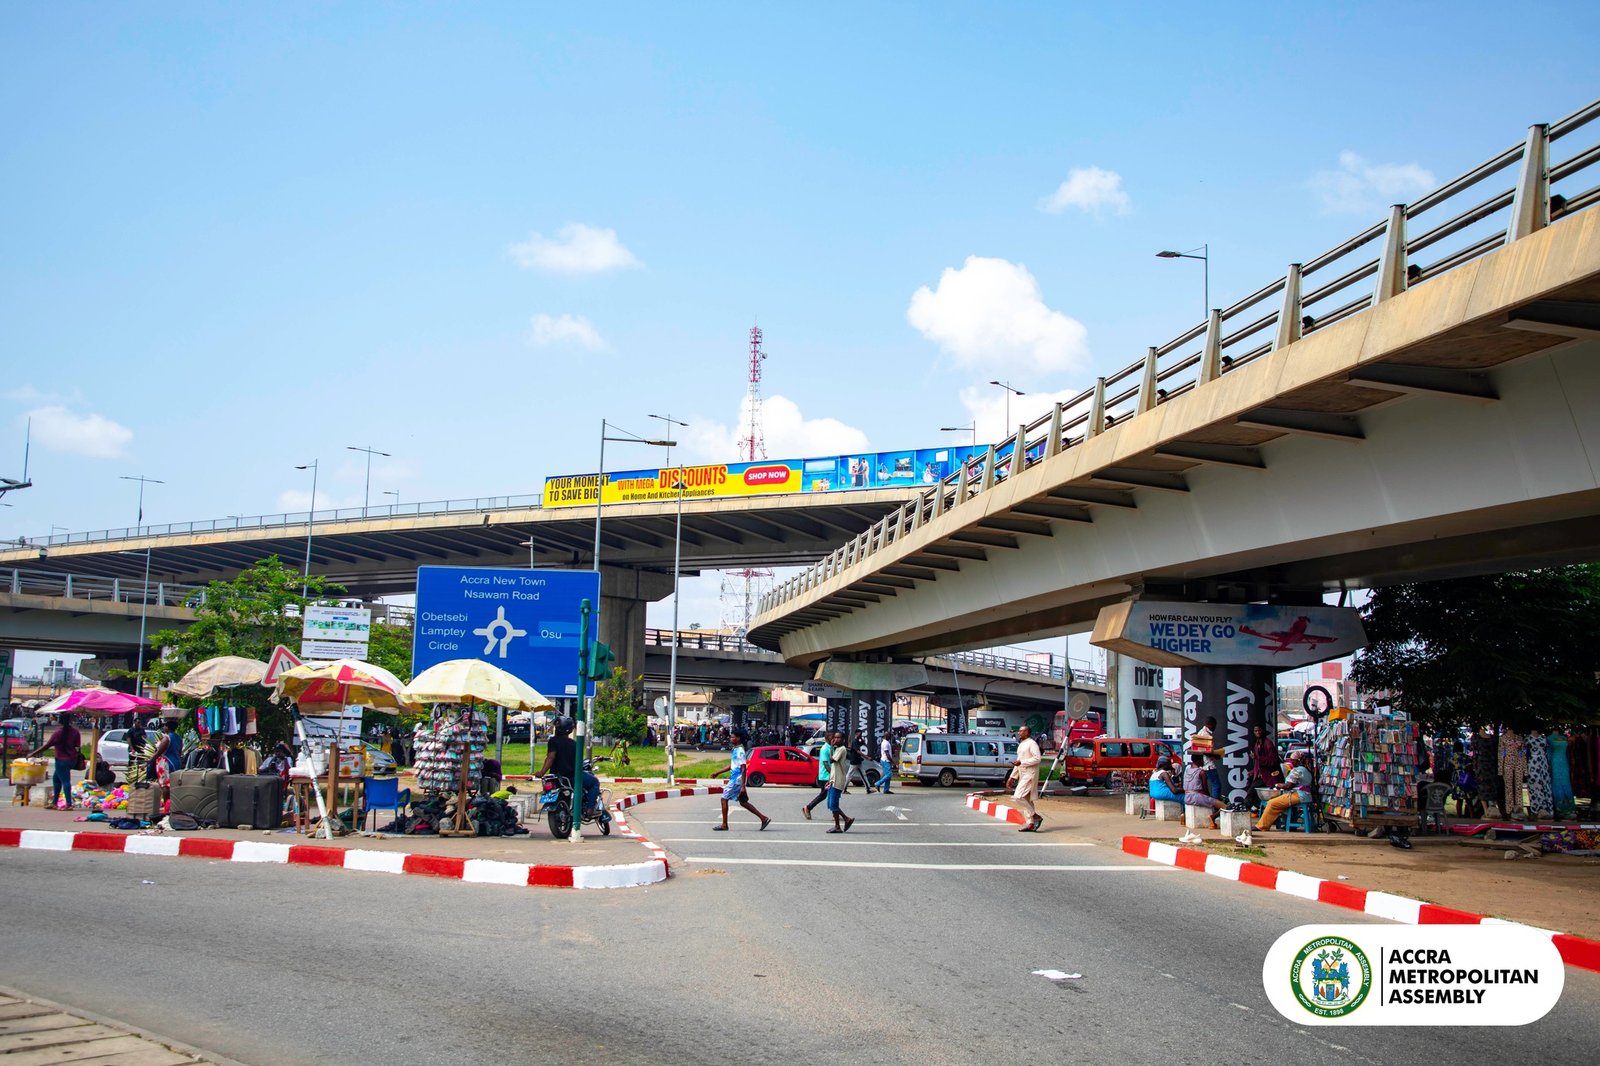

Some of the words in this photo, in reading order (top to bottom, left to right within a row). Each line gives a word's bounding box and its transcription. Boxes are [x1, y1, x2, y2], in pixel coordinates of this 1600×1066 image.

[618, 480, 634, 490] WITH
[636, 478, 654, 490] MEGA
[660, 466, 726, 488] DISCOUNTS
[550, 478, 572, 490] YOUR
[550, 490, 560, 502] TO
[562, 489, 582, 500] SAVE
[584, 488, 598, 500] BIG
[682, 488, 714, 498] Appliances
[460, 576, 490, 584] Accra
[494, 576, 516, 585] New
[520, 577, 546, 586] Town
[464, 590, 508, 600] Nsawam
[512, 592, 540, 600] Road
[422, 612, 468, 622] Obetsebi
[422, 627, 466, 638] Lamptey
[541, 630, 562, 639] Osu
[1150, 623, 1176, 636] WE
[1178, 624, 1210, 637] DEY
[1212, 624, 1236, 638] GO
[428, 641, 458, 650] Circle
[1151, 638, 1212, 652] HIGHER
[1183, 680, 1202, 765] tway
